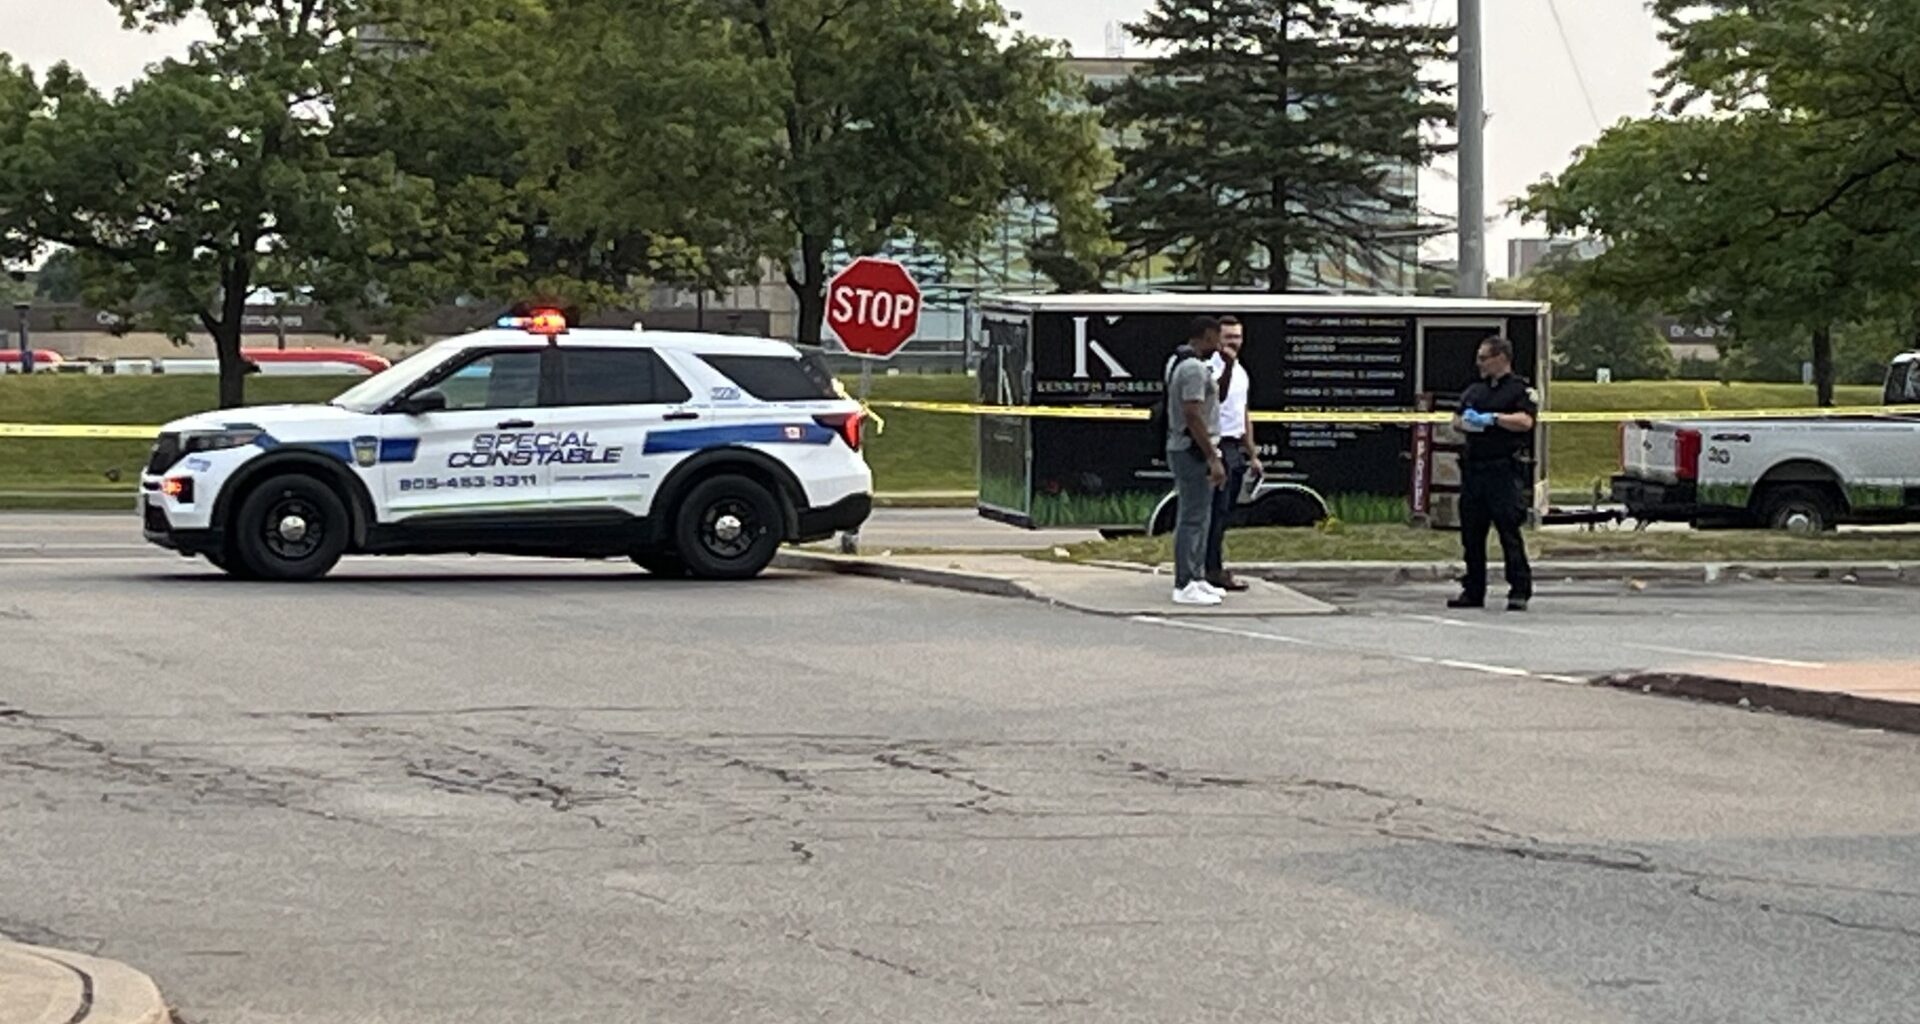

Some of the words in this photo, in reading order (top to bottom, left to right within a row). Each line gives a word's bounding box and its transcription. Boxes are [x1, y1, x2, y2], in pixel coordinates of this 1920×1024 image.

[832, 286, 914, 329] STOP
[473, 431, 599, 450] SPECIAL
[447, 446, 624, 468] CONSTABLE
